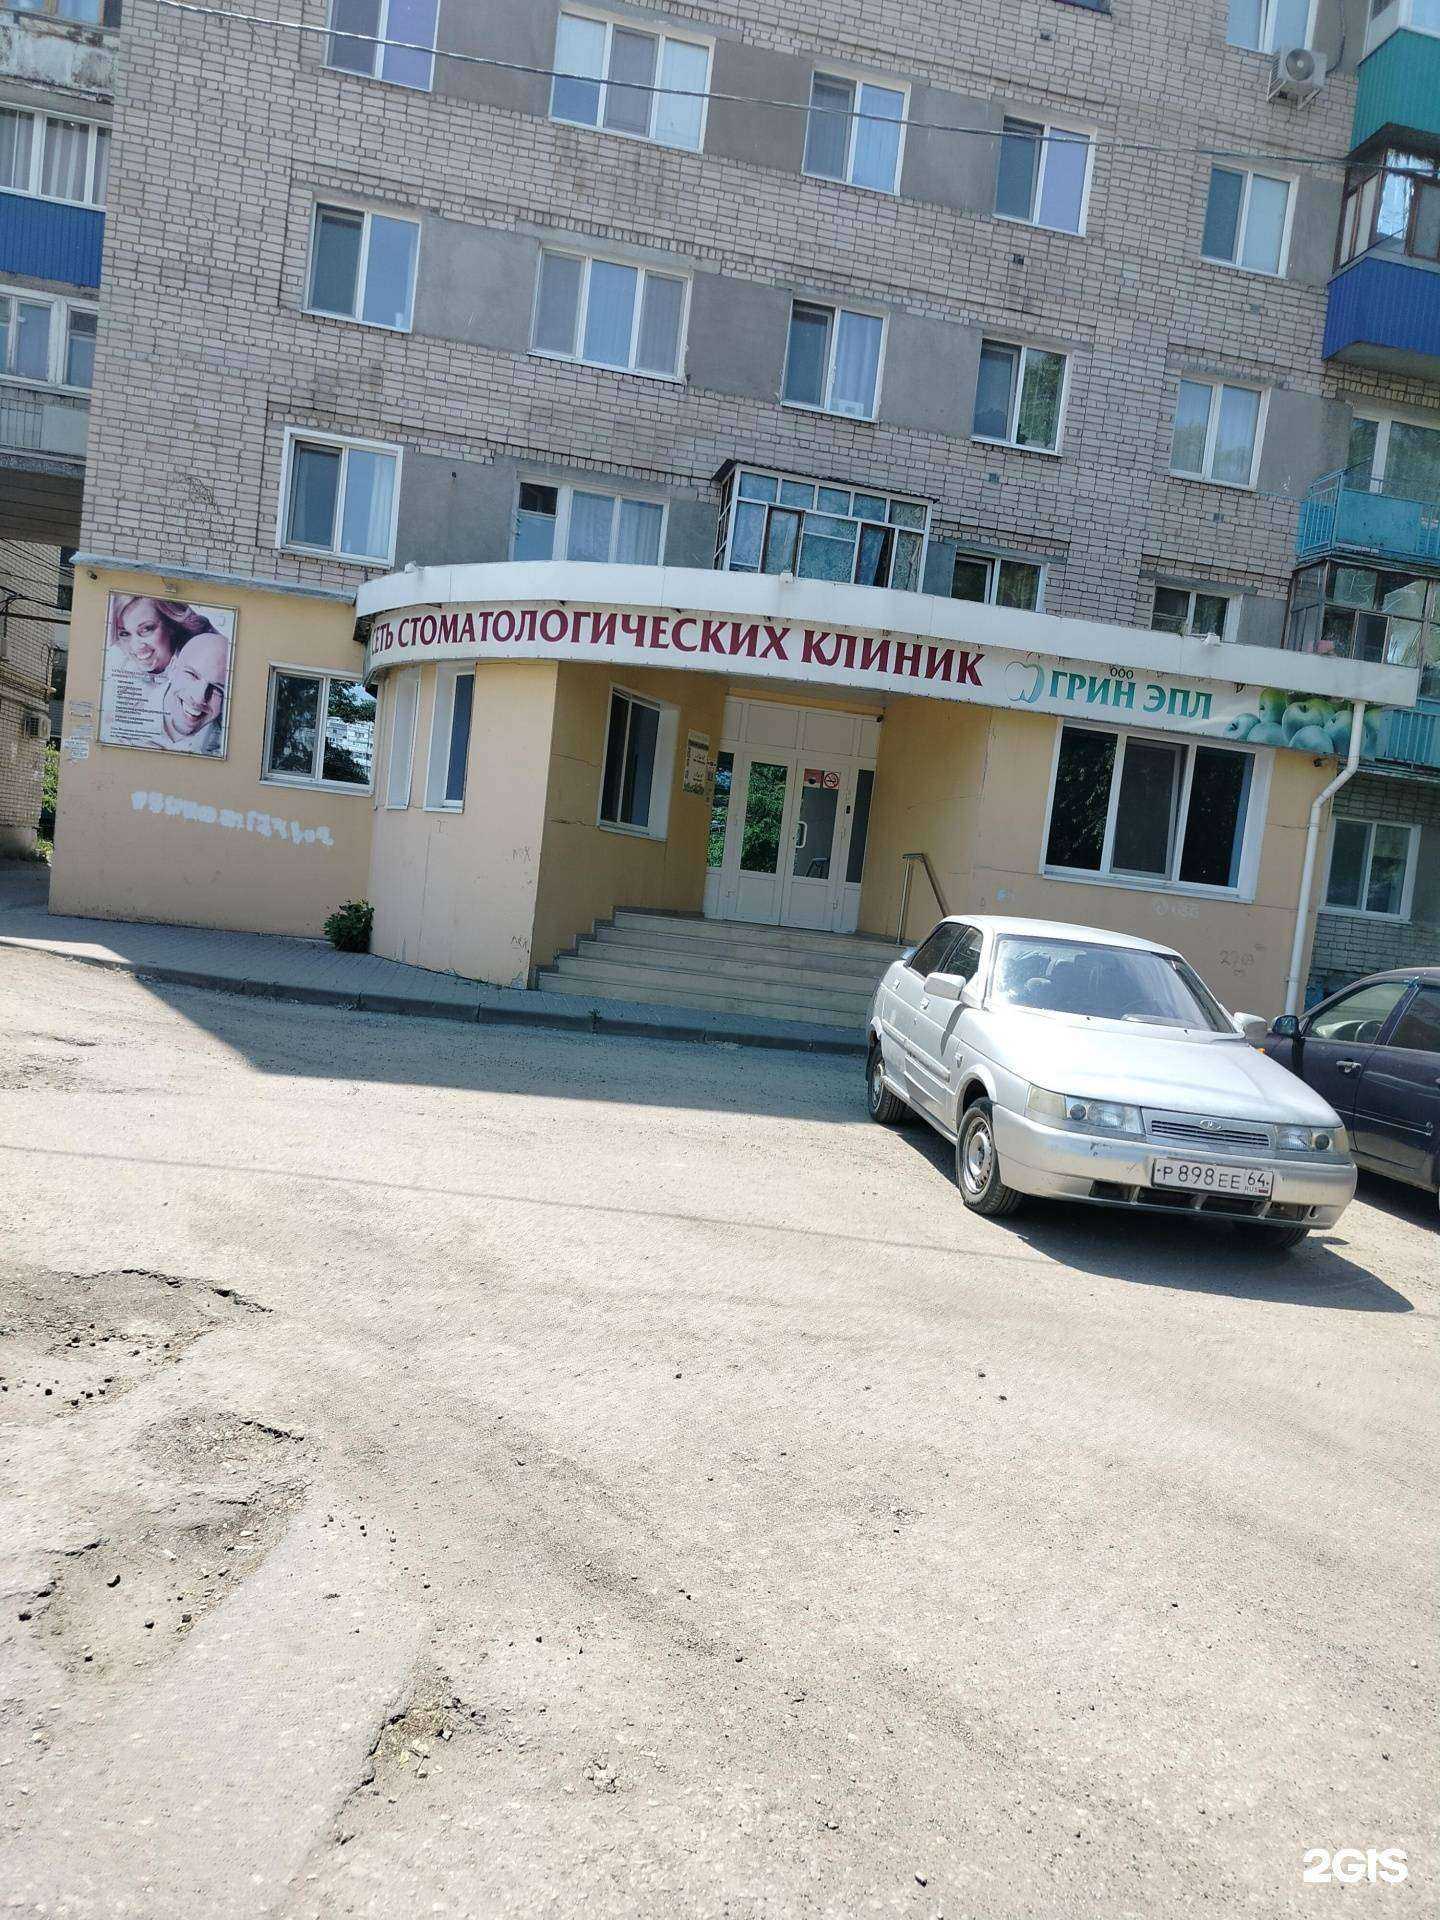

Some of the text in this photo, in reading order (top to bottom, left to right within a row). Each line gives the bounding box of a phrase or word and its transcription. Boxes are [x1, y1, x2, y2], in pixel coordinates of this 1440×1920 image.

[397, 610, 791, 661] СТОМАТОЛОГИЧЕСКИХ
[801, 629, 985, 687] КЛИНИК
[1110, 666, 1134, 680] ООО
[1048, 669, 1214, 721] ГРИН ЭПЛ
